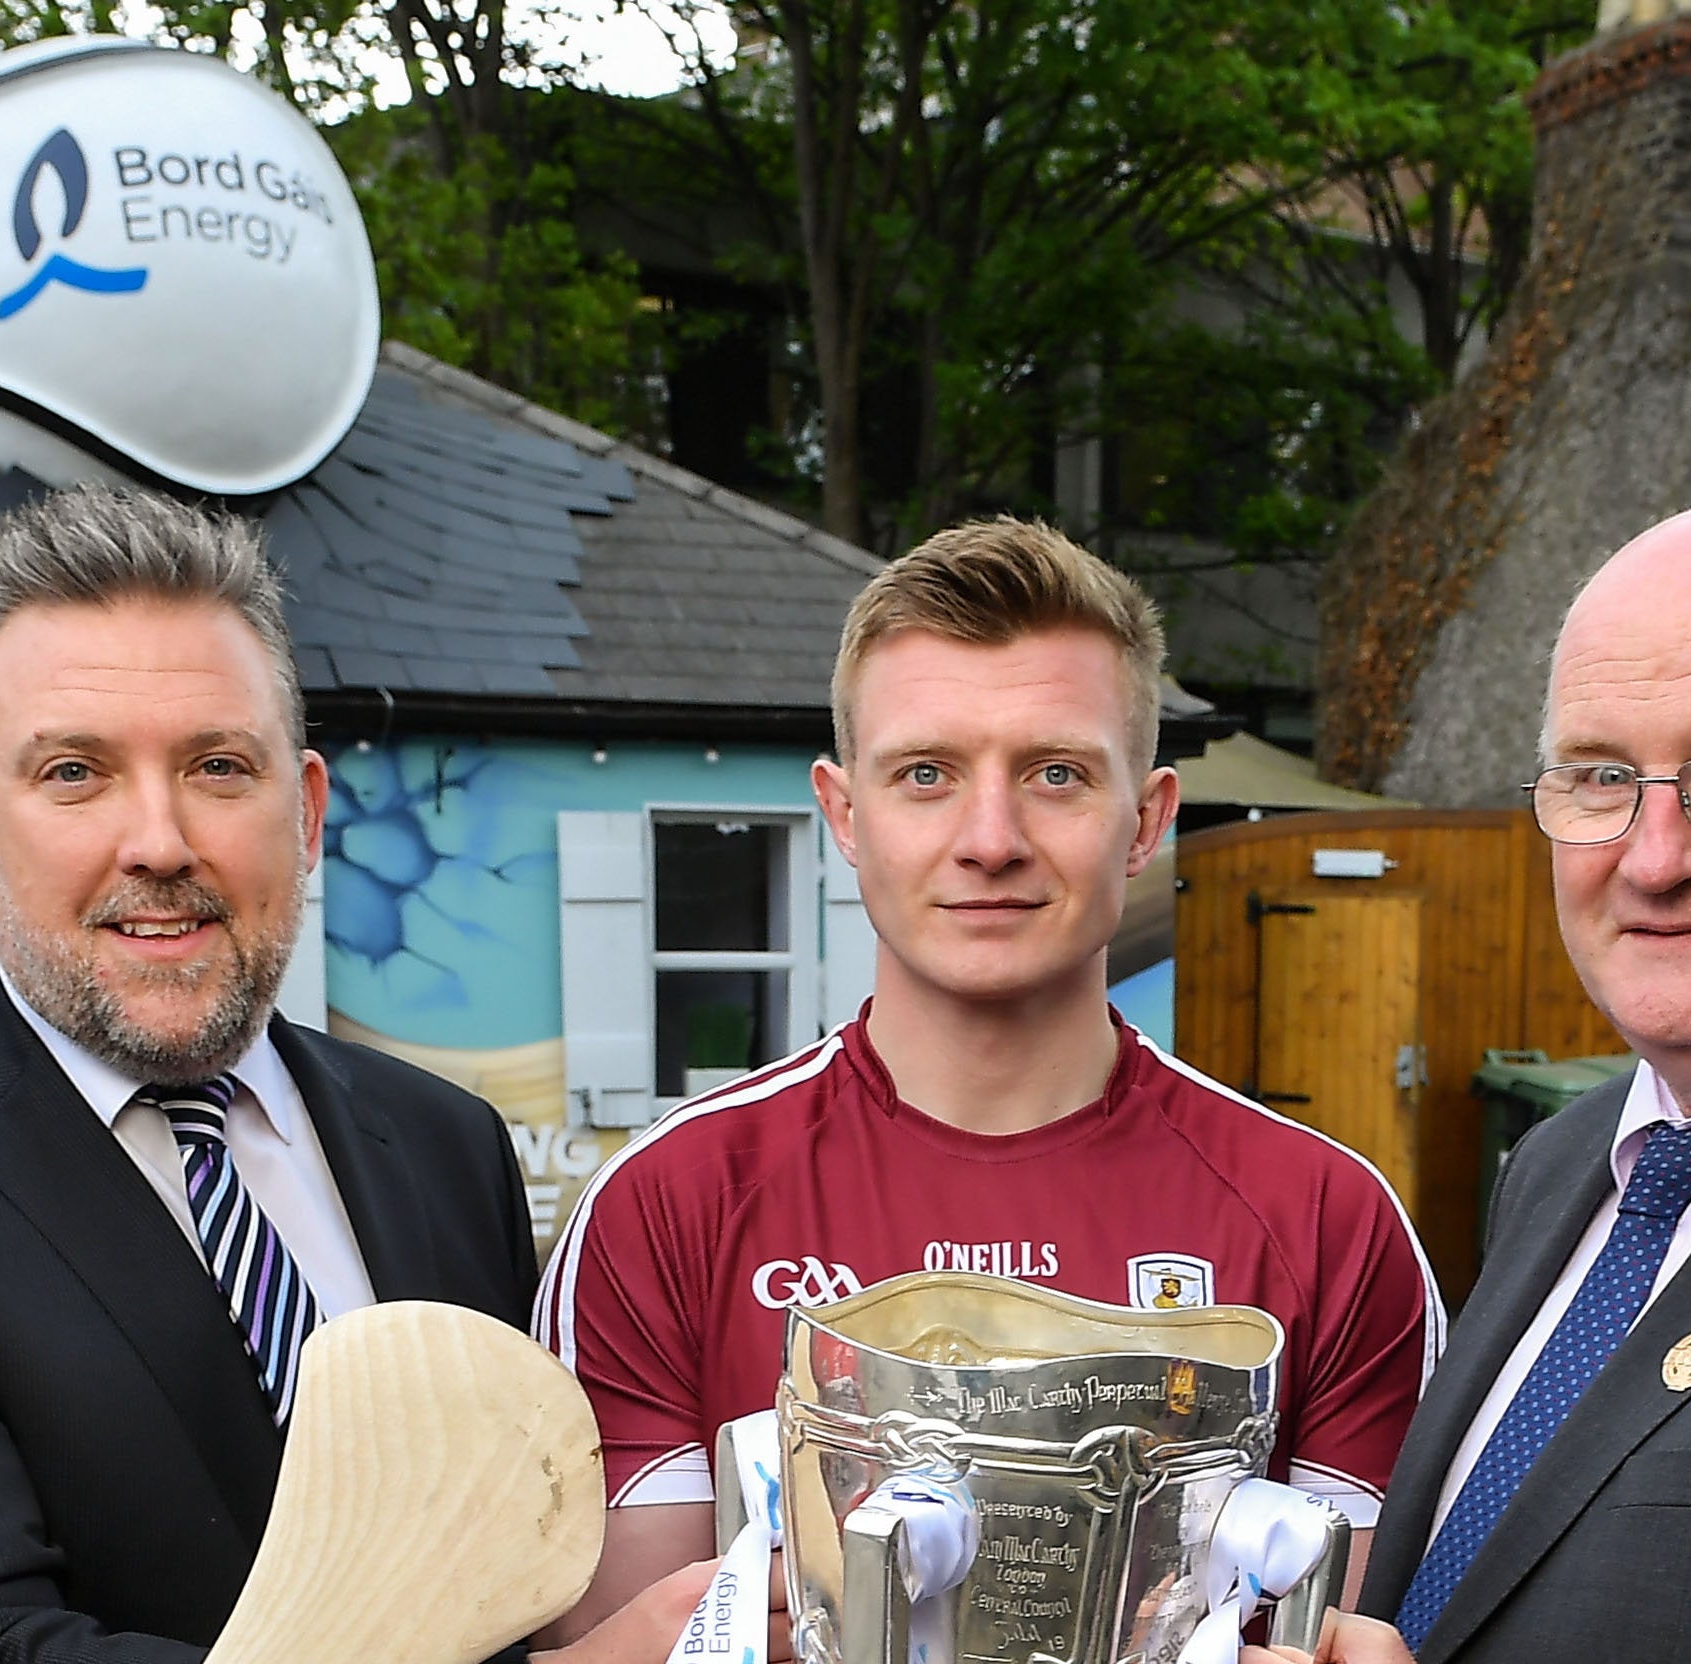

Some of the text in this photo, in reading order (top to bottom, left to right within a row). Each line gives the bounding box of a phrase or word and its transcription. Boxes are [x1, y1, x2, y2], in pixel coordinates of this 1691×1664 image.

[115, 146, 245, 191] Bord
[120, 197, 295, 262] Energy
[752, 1256, 864, 1309] GAA
[924, 1241, 1060, 1278] O'NEILLS
[709, 1572, 738, 1653] Energy
